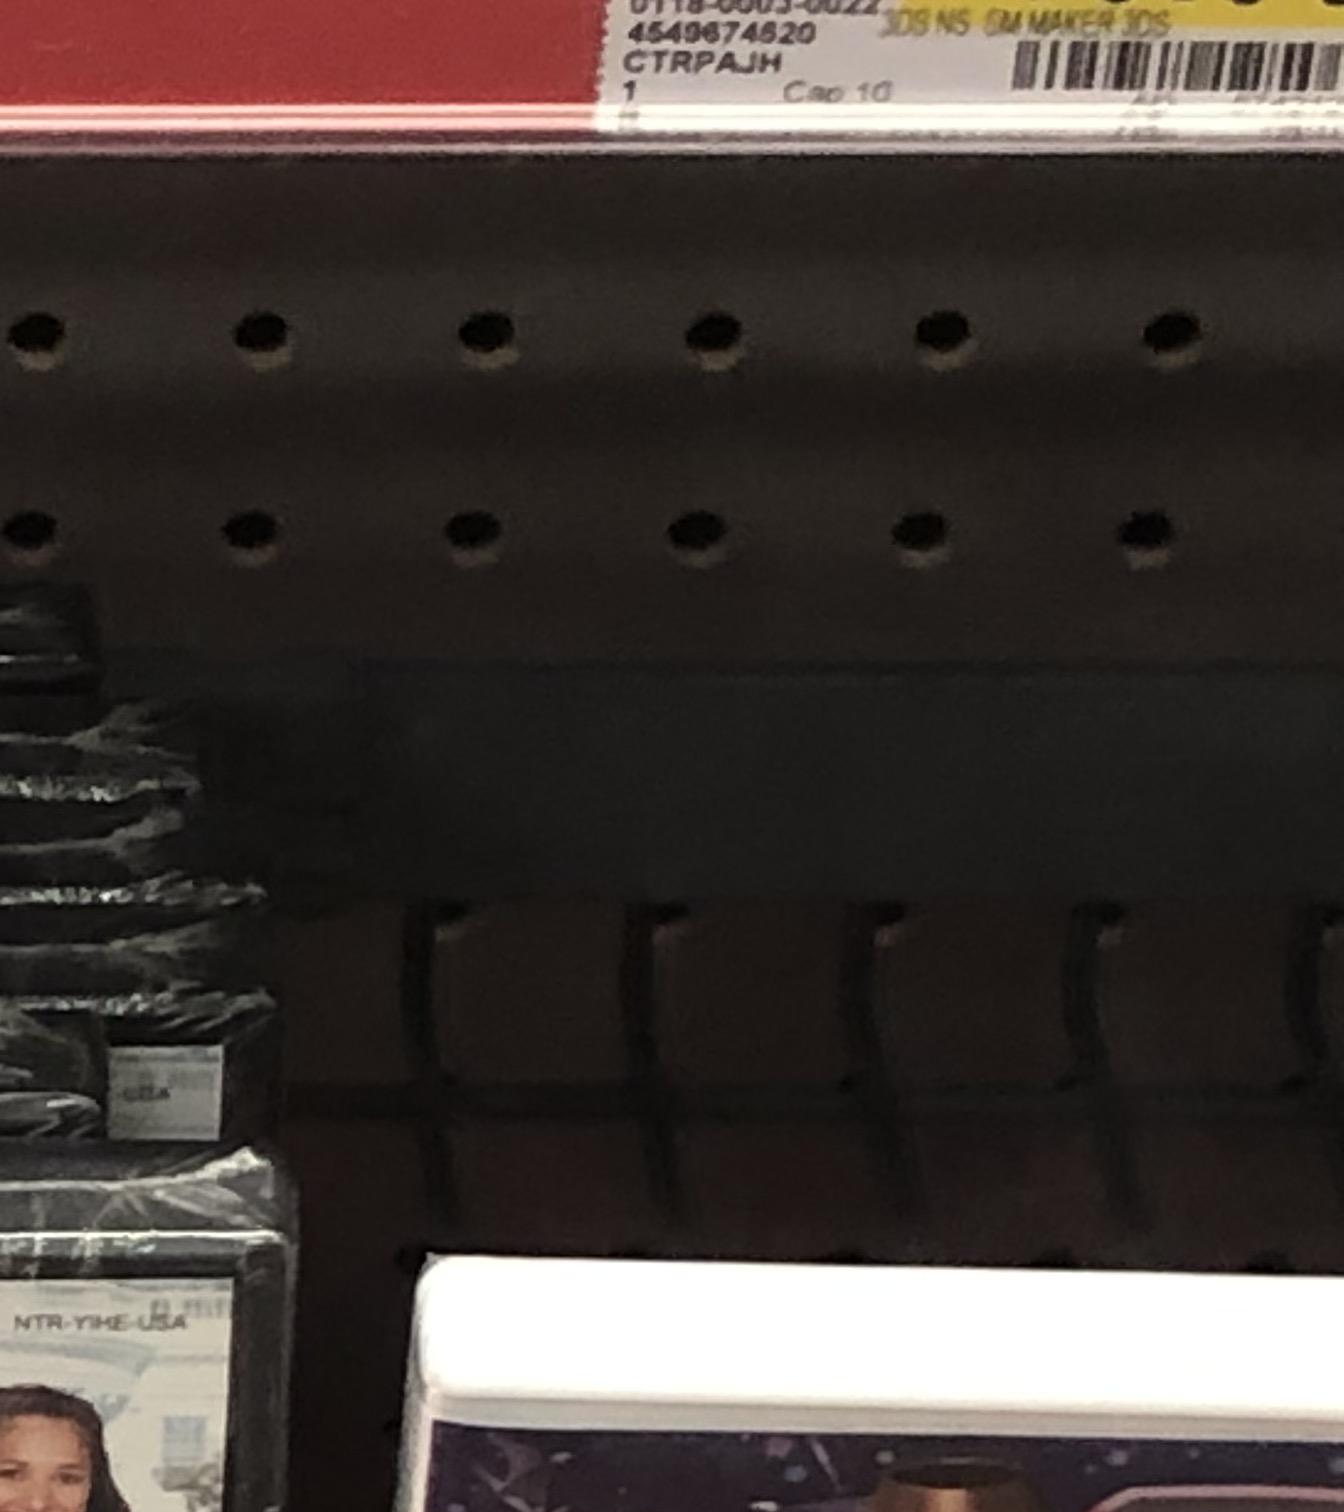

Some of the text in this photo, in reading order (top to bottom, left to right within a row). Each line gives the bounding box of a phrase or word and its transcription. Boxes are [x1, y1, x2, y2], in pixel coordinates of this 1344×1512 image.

[623, 50, 782, 74] CTRPAJH
[623, 80, 894, 103] 1 Cap 10
